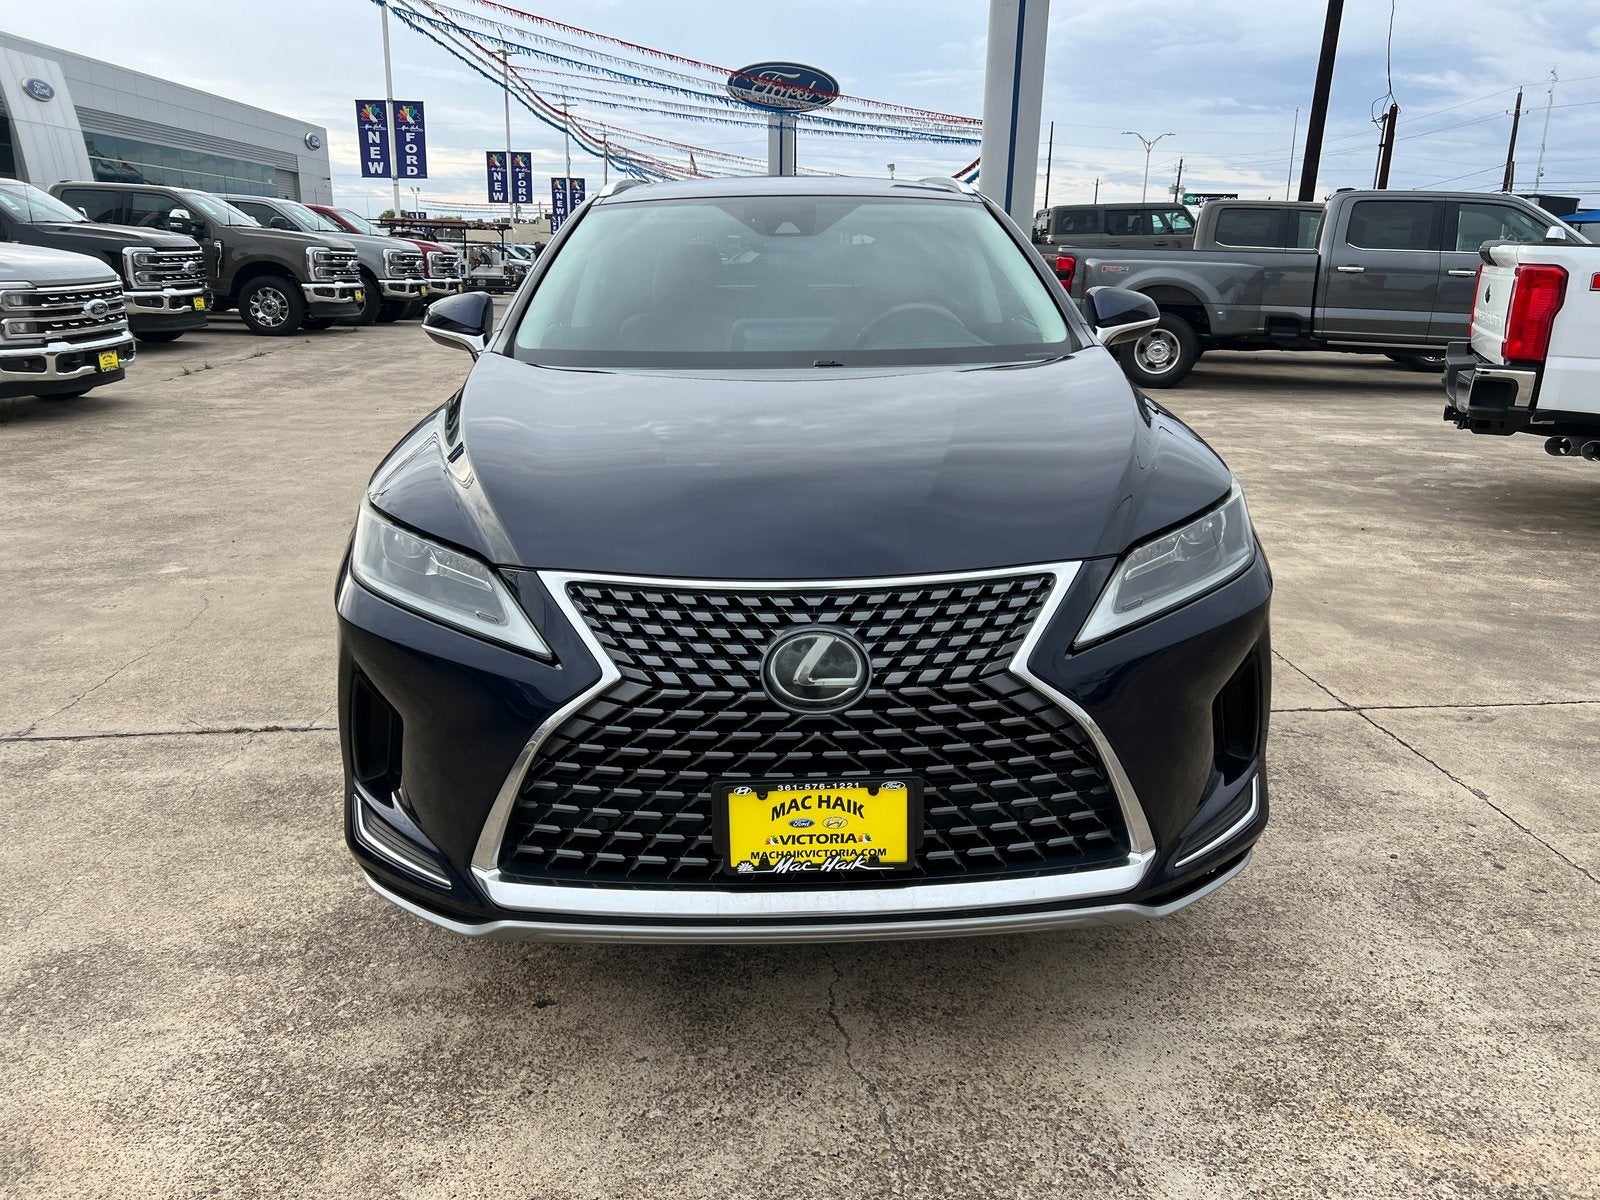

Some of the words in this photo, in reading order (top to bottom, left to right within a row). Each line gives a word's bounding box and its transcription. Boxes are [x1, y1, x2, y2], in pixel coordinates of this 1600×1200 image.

[751, 70, 817, 101] Ford
[367, 131, 384, 174] NEW
[404, 132, 419, 176] FORD
[492, 171, 504, 201] NEW
[517, 172, 527, 202] FORD
[556, 192, 565, 215] NEW
[777, 782, 860, 792] 361-576-1221
[771, 795, 812, 822] MAC
[817, 794, 865, 820] HAIK
[779, 833, 858, 846] VICTORIA
[772, 856, 820, 874] Mac
[819, 855, 870, 873] Haik
